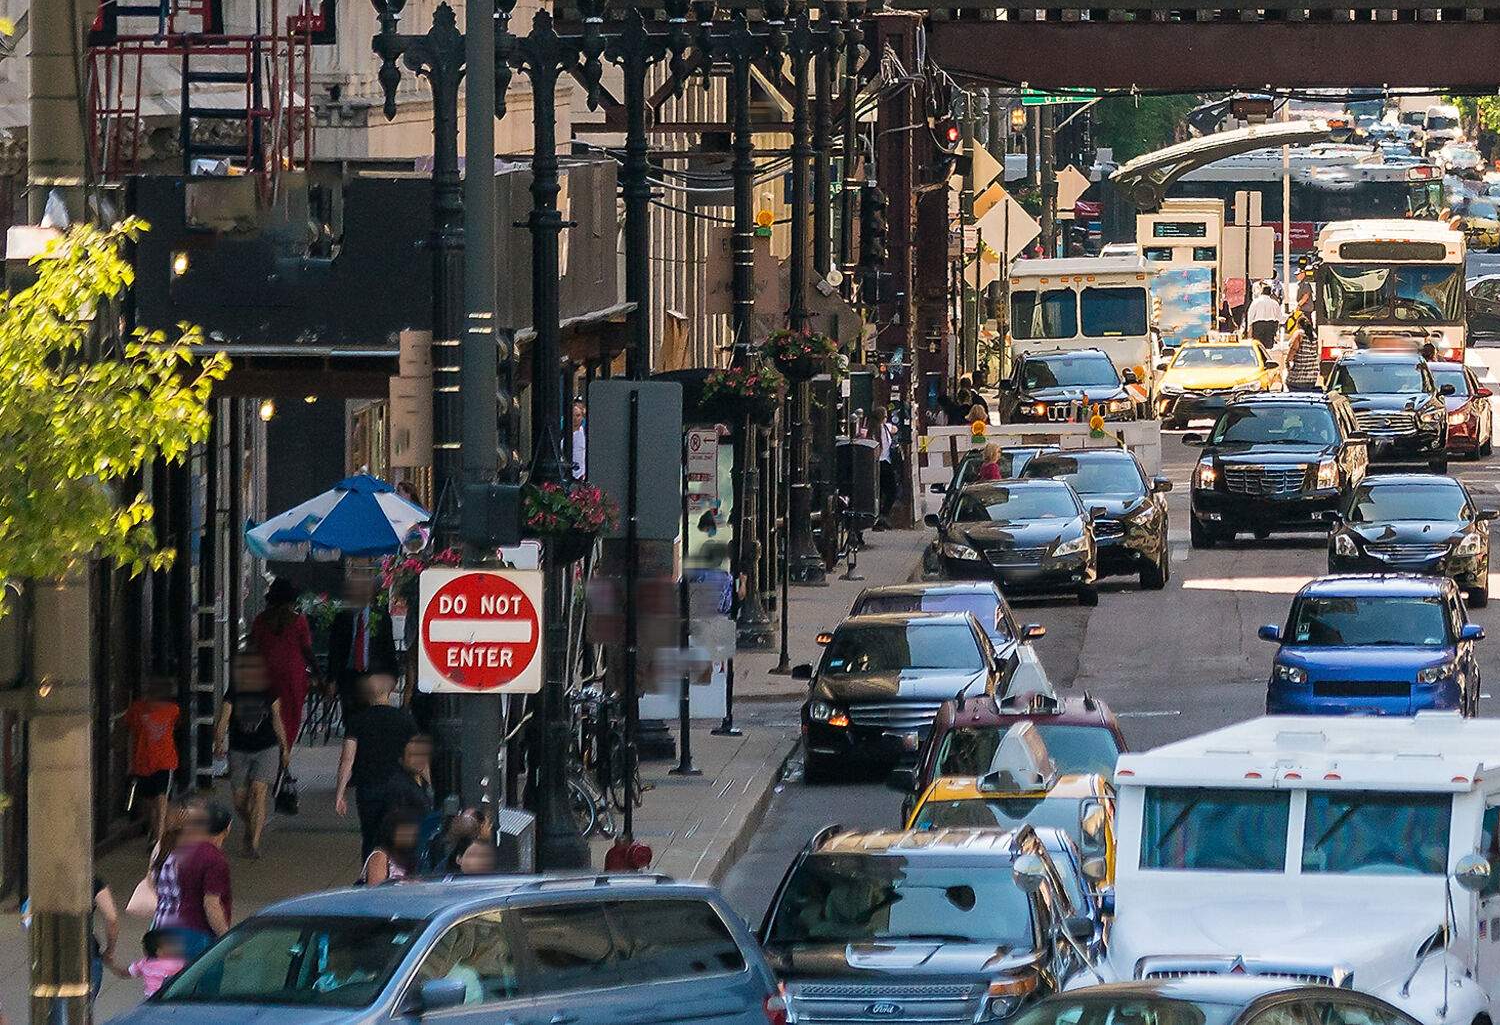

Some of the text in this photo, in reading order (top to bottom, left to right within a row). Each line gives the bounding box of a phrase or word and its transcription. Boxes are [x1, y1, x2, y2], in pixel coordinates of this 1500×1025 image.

[438, 594, 523, 615] DO NOT
[446, 647, 514, 668] ENTER
